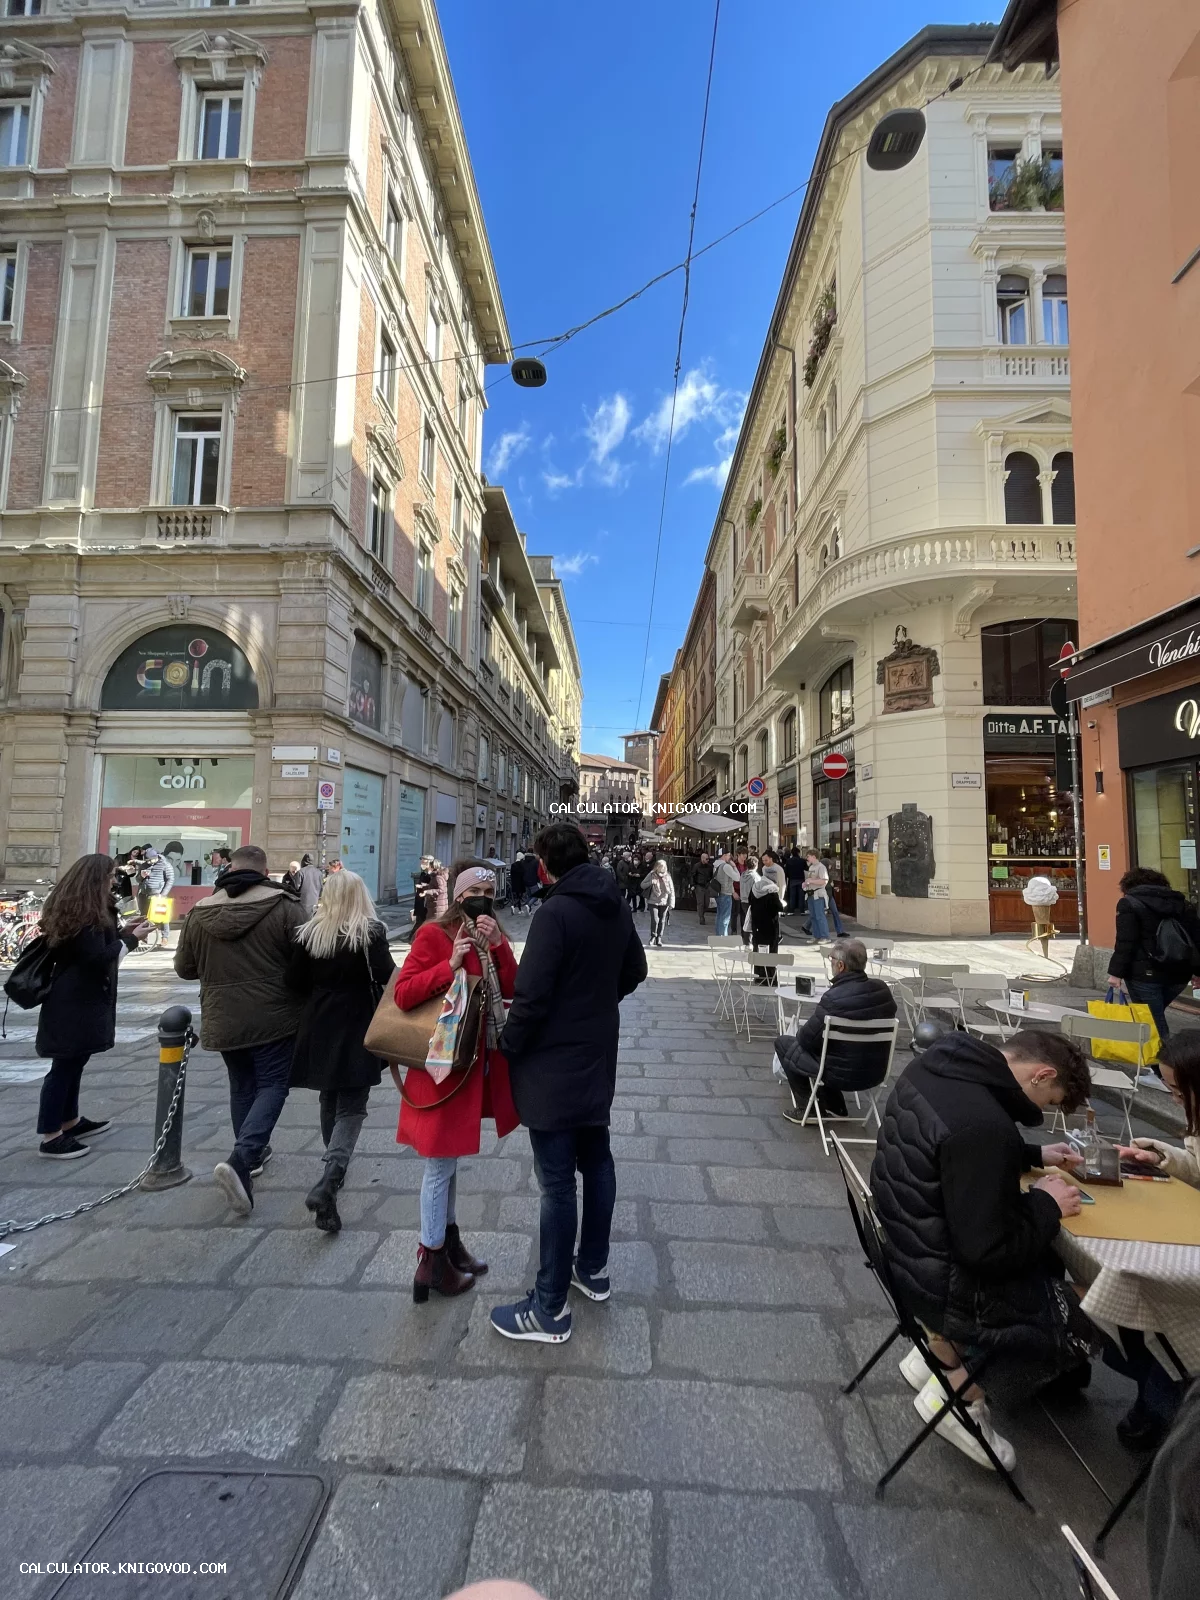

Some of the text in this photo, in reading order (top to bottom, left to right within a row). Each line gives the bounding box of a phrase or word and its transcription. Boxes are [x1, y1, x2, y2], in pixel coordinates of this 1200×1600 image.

[136, 638, 232, 689] coin
[1149, 631, 1200, 668] Venchi
[988, 721, 1015, 733] Ditta
[1019, 719, 1044, 733] A.F.
[160, 765, 206, 789] coin
